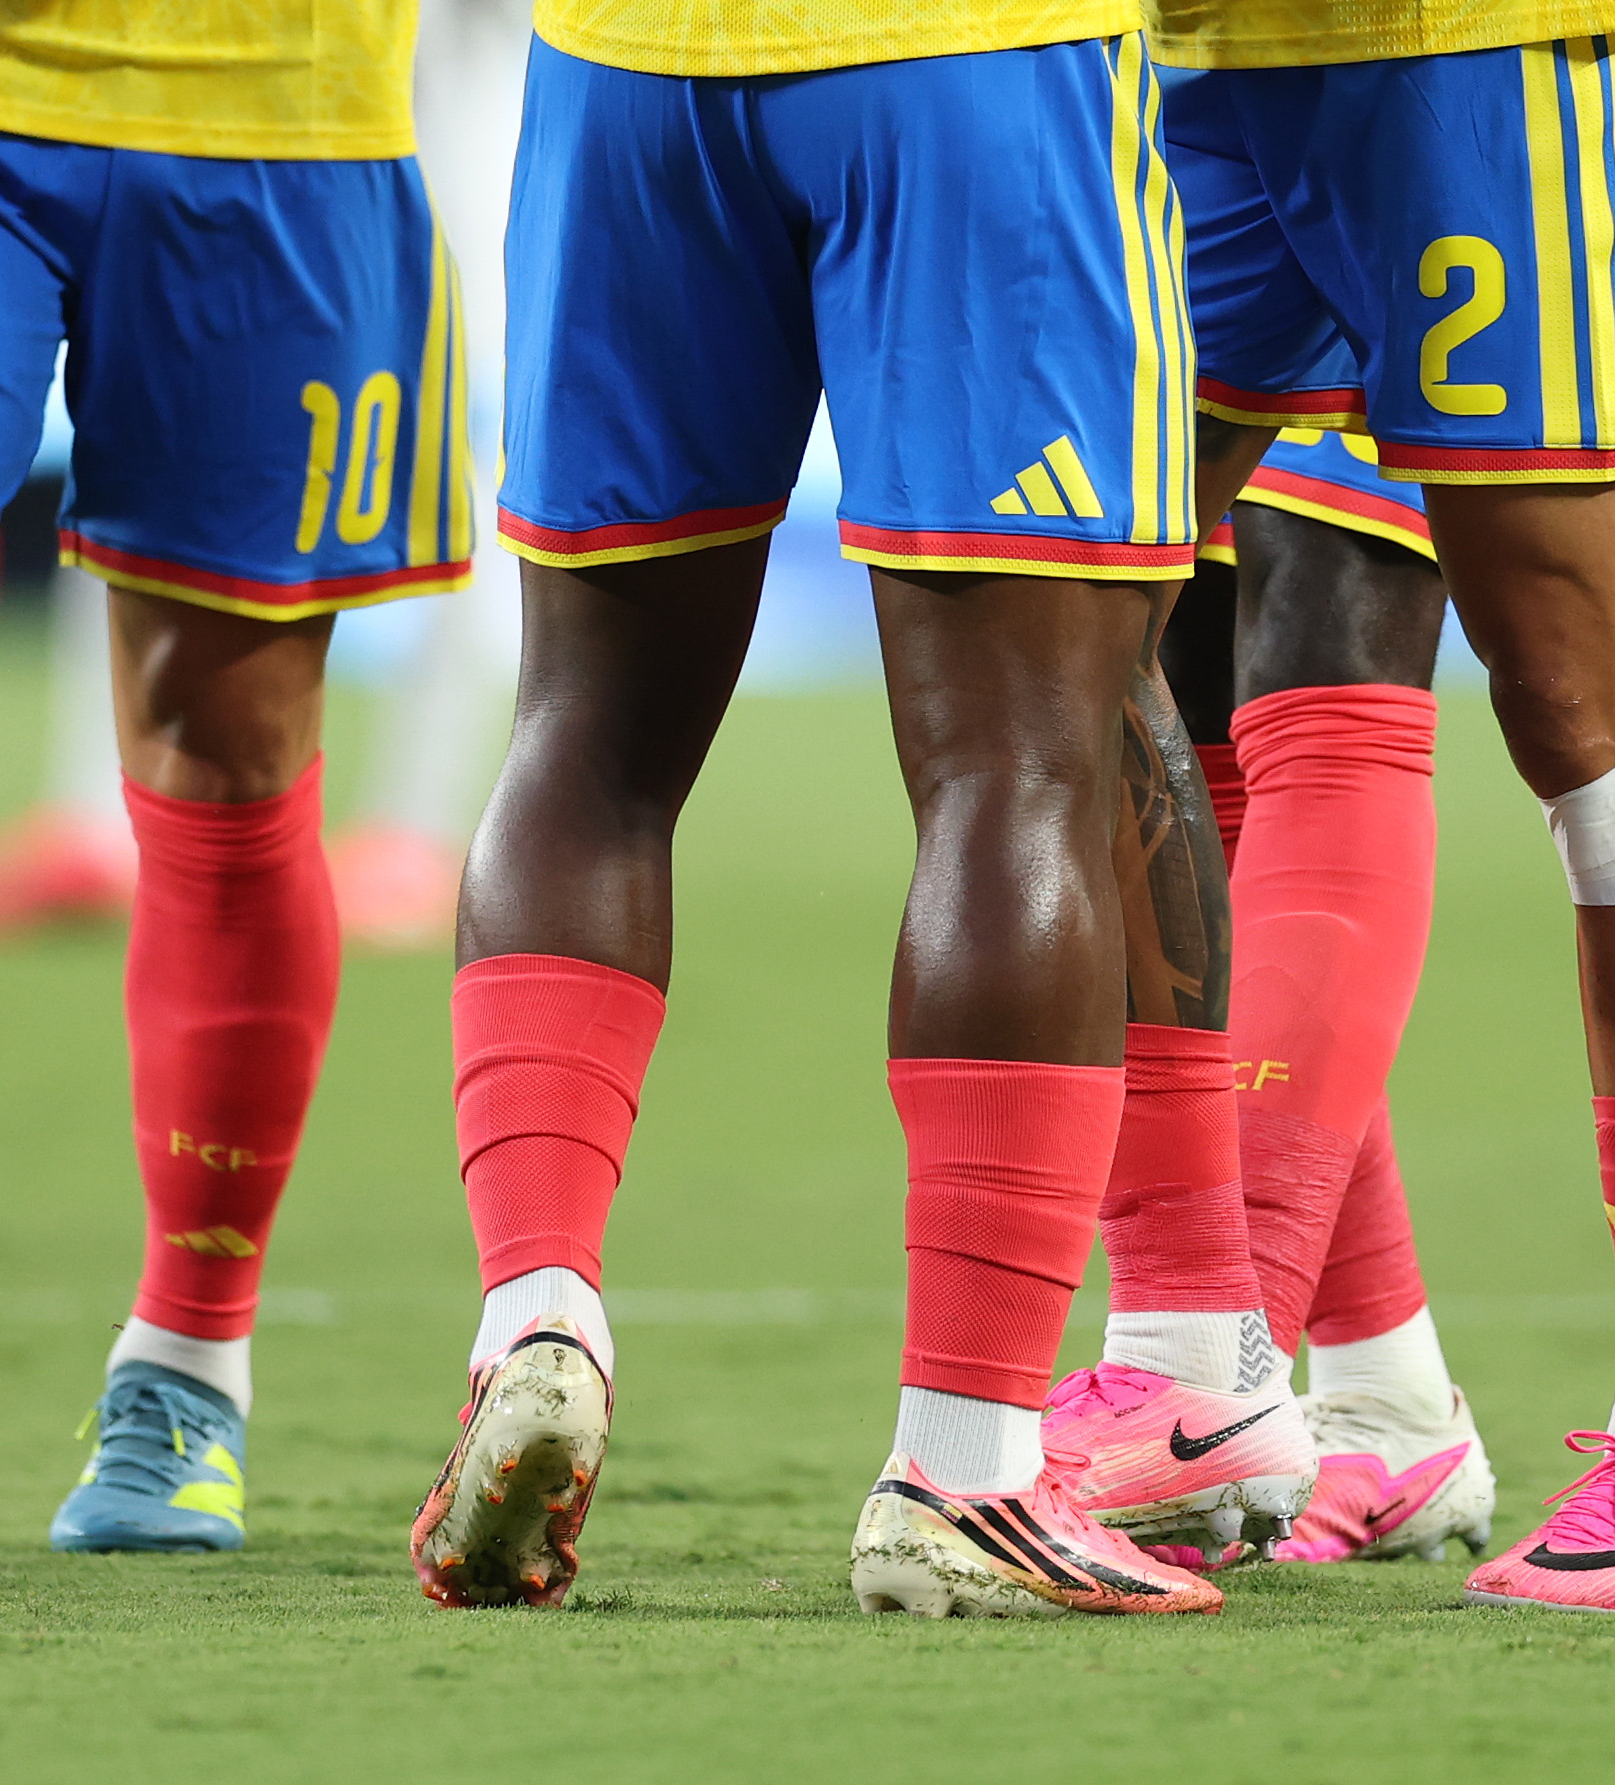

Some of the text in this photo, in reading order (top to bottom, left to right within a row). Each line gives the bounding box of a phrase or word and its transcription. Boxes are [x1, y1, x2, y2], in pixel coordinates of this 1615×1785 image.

[1418, 234, 1507, 416] 2
[295, 369, 402, 554] 10
[1232, 1059, 1290, 1091] CF
[169, 1128, 258, 1173] FCF
